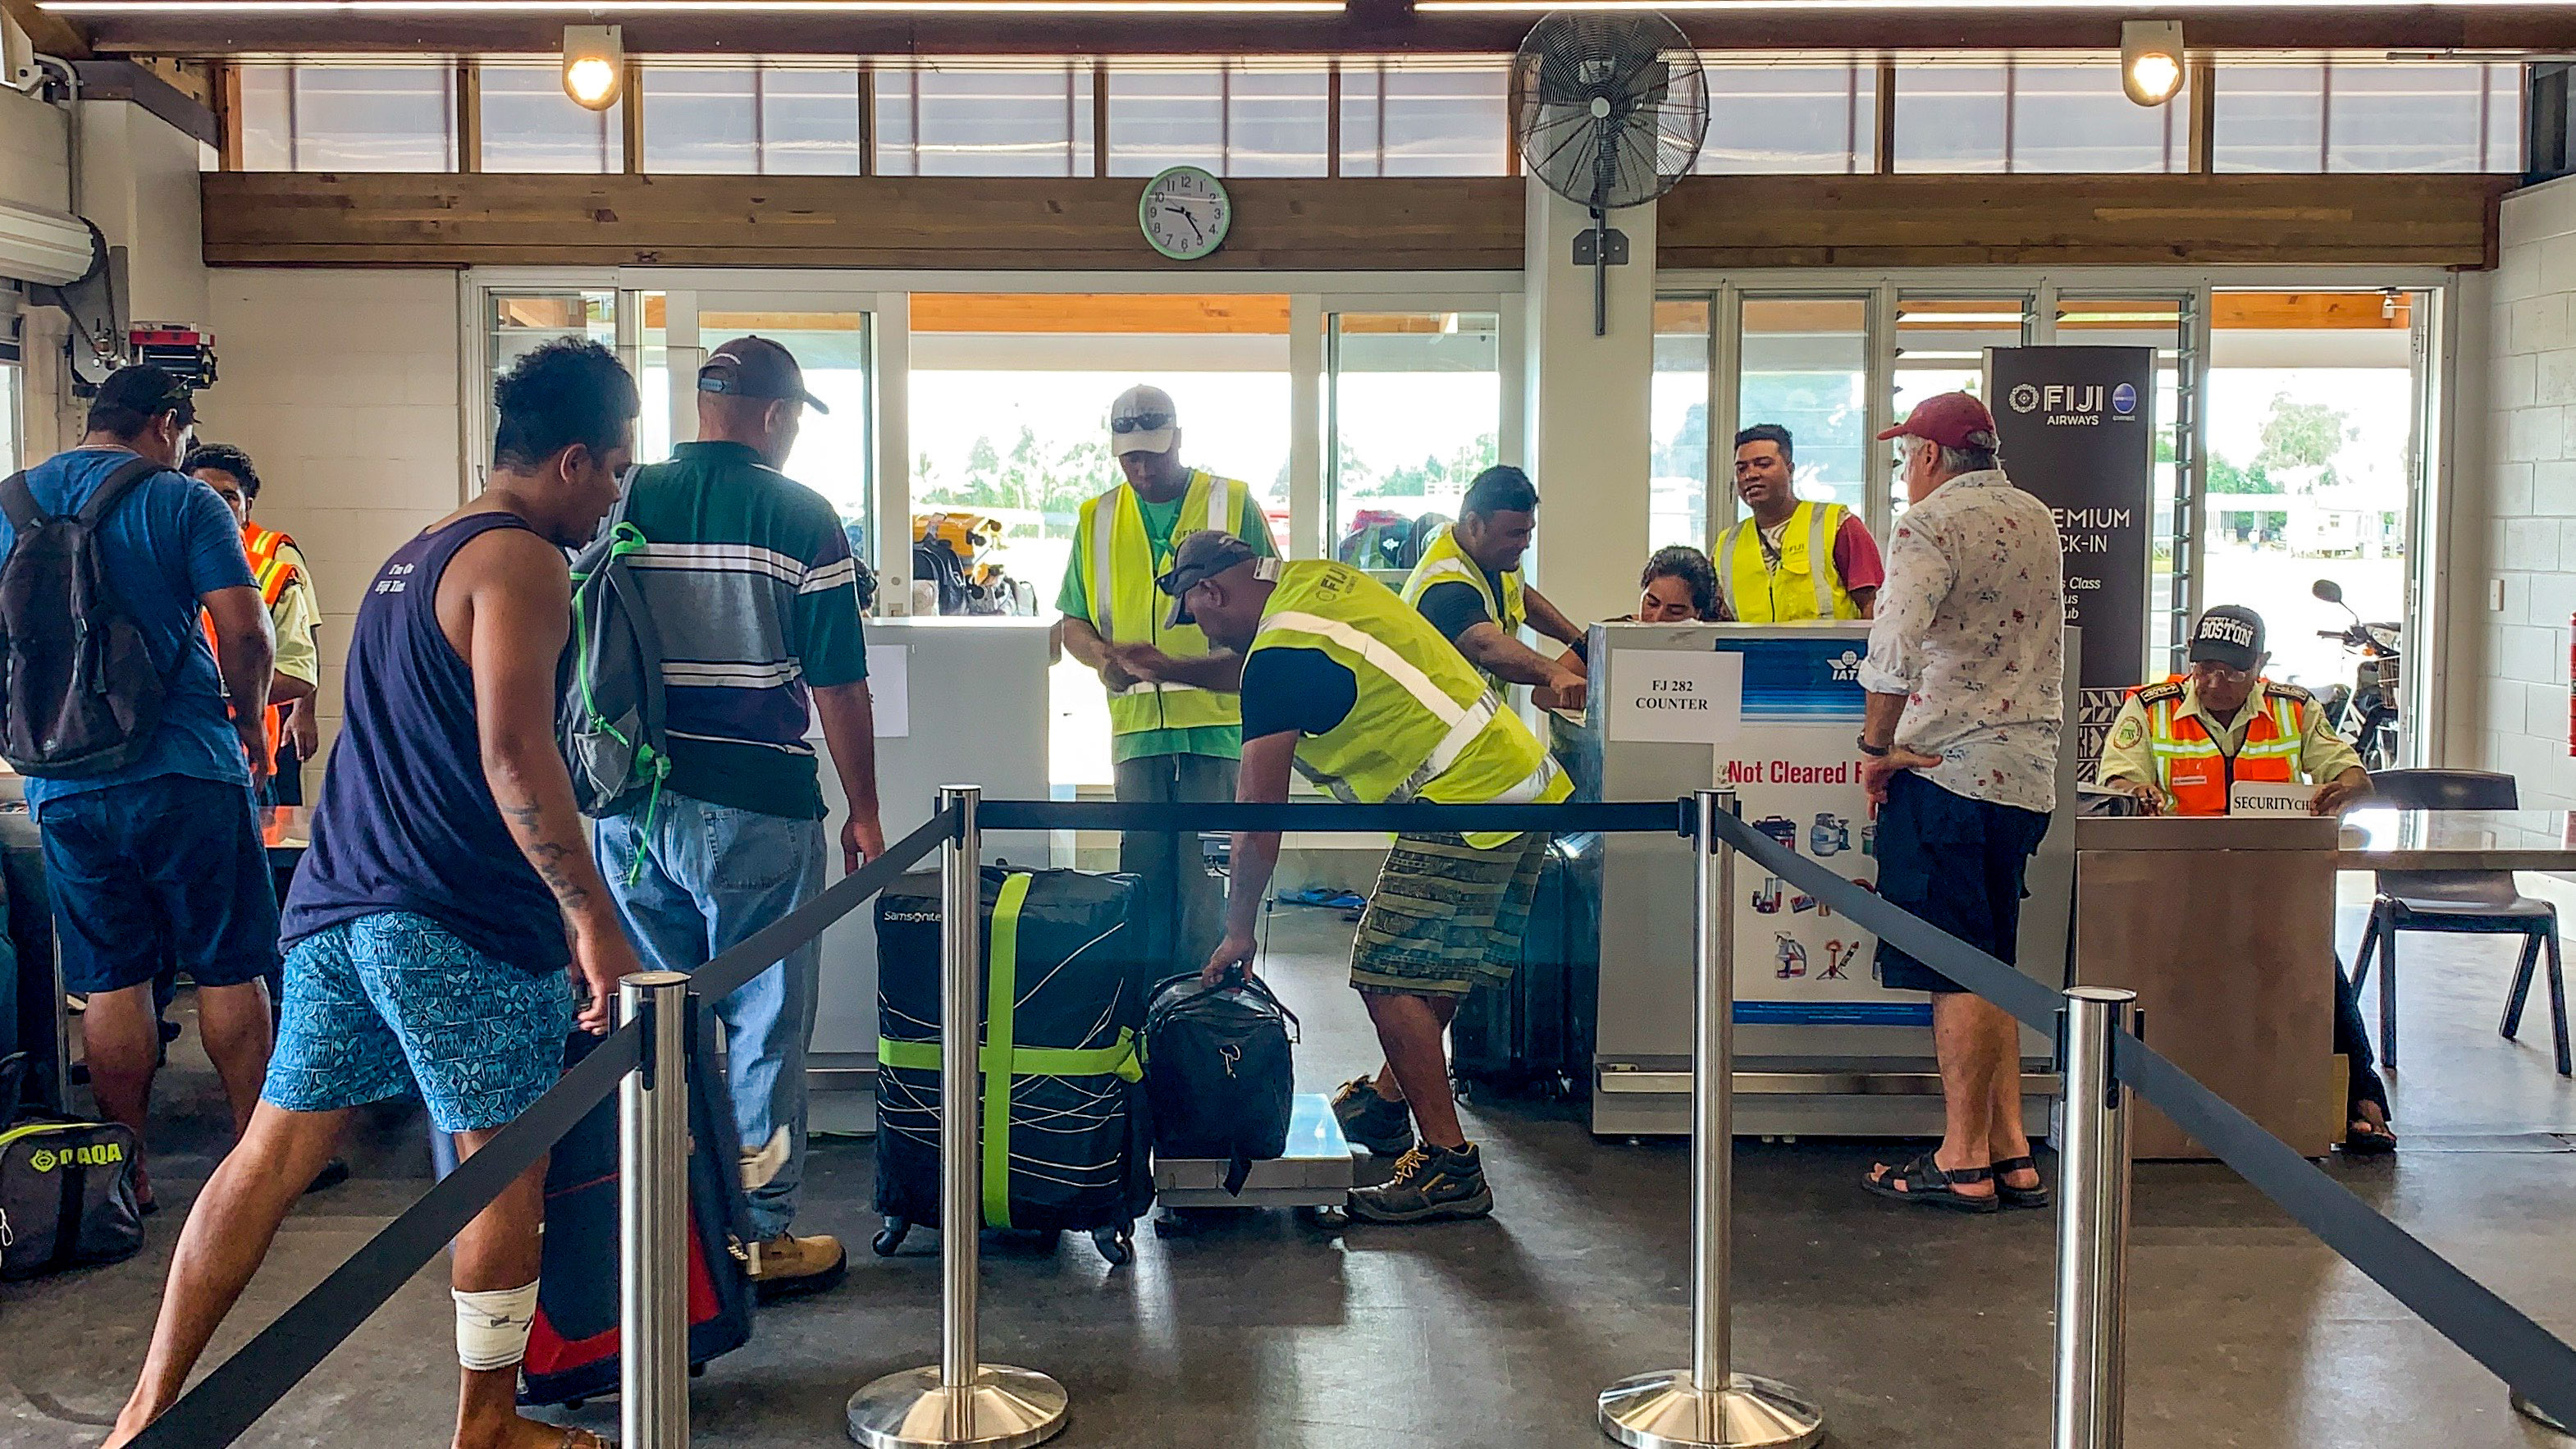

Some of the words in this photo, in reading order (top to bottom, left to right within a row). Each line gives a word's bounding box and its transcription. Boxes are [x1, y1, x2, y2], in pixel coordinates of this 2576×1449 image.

[1167, 180, 1175, 191] 11
[1181, 176, 1191, 187] 12
[1199, 181, 1204, 192] 1
[1155, 192, 1164, 203] 10
[1209, 194, 1216, 204] 2
[1150, 208, 1157, 217] 9
[1214, 208, 1221, 219] 3
[1154, 222, 1160, 233] 8
[1209, 224, 1216, 234] 4
[1166, 234, 1173, 245] 7
[1181, 239, 1188, 249] 6
[1197, 235, 1203, 245] 5
[2044, 385, 2103, 412] FIJI
[2047, 414, 2099, 426] AIRWAYS
[2052, 508, 2131, 528] EMIUM
[2059, 534, 2108, 553] CK-IN
[2069, 577, 2101, 590] Class
[2064, 595, 2079, 605] us
[2064, 608, 2079, 619] ub
[2199, 621, 2254, 647] BOSTON
[1832, 670, 1857, 680] IAT
[1652, 680, 1667, 691] FJ
[1672, 681, 1693, 692] 282
[1636, 697, 1708, 710] COUNTER
[1729, 761, 1763, 784] Not
[1770, 761, 1847, 784] Cleared
[2234, 797, 2295, 810] SECURITY
[884, 911, 942, 922] Samsonite
